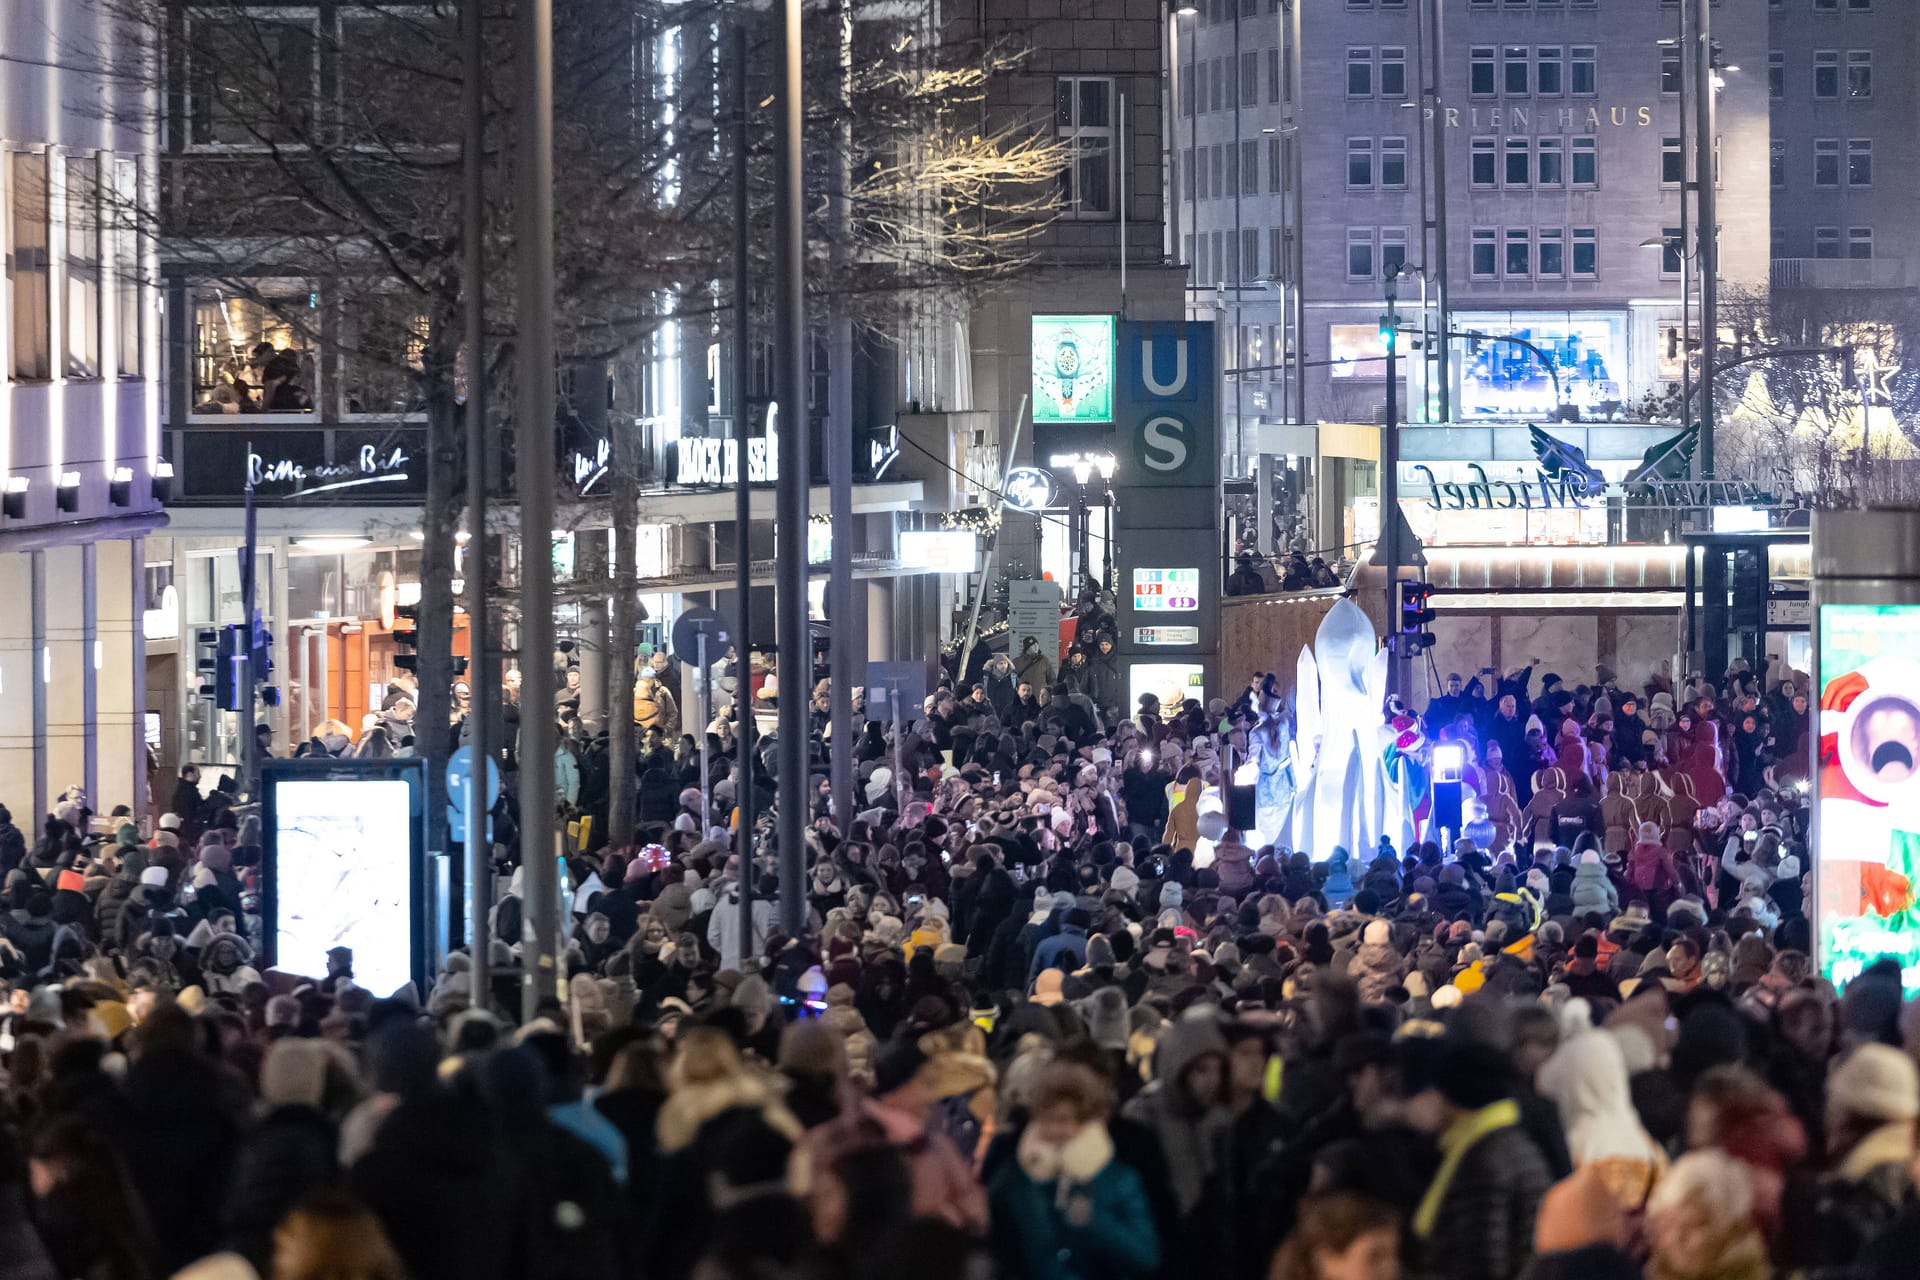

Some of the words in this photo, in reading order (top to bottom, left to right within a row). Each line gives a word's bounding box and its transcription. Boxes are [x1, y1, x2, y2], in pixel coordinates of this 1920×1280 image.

[1142, 340, 1188, 397] U
[249, 453, 307, 485] Bitte
[360, 444, 410, 473] Bit
[677, 436, 721, 484] BLOCK
[722, 437, 766, 483] HSE
[1143, 416, 1187, 471] S
[1141, 584, 1157, 595] U2
